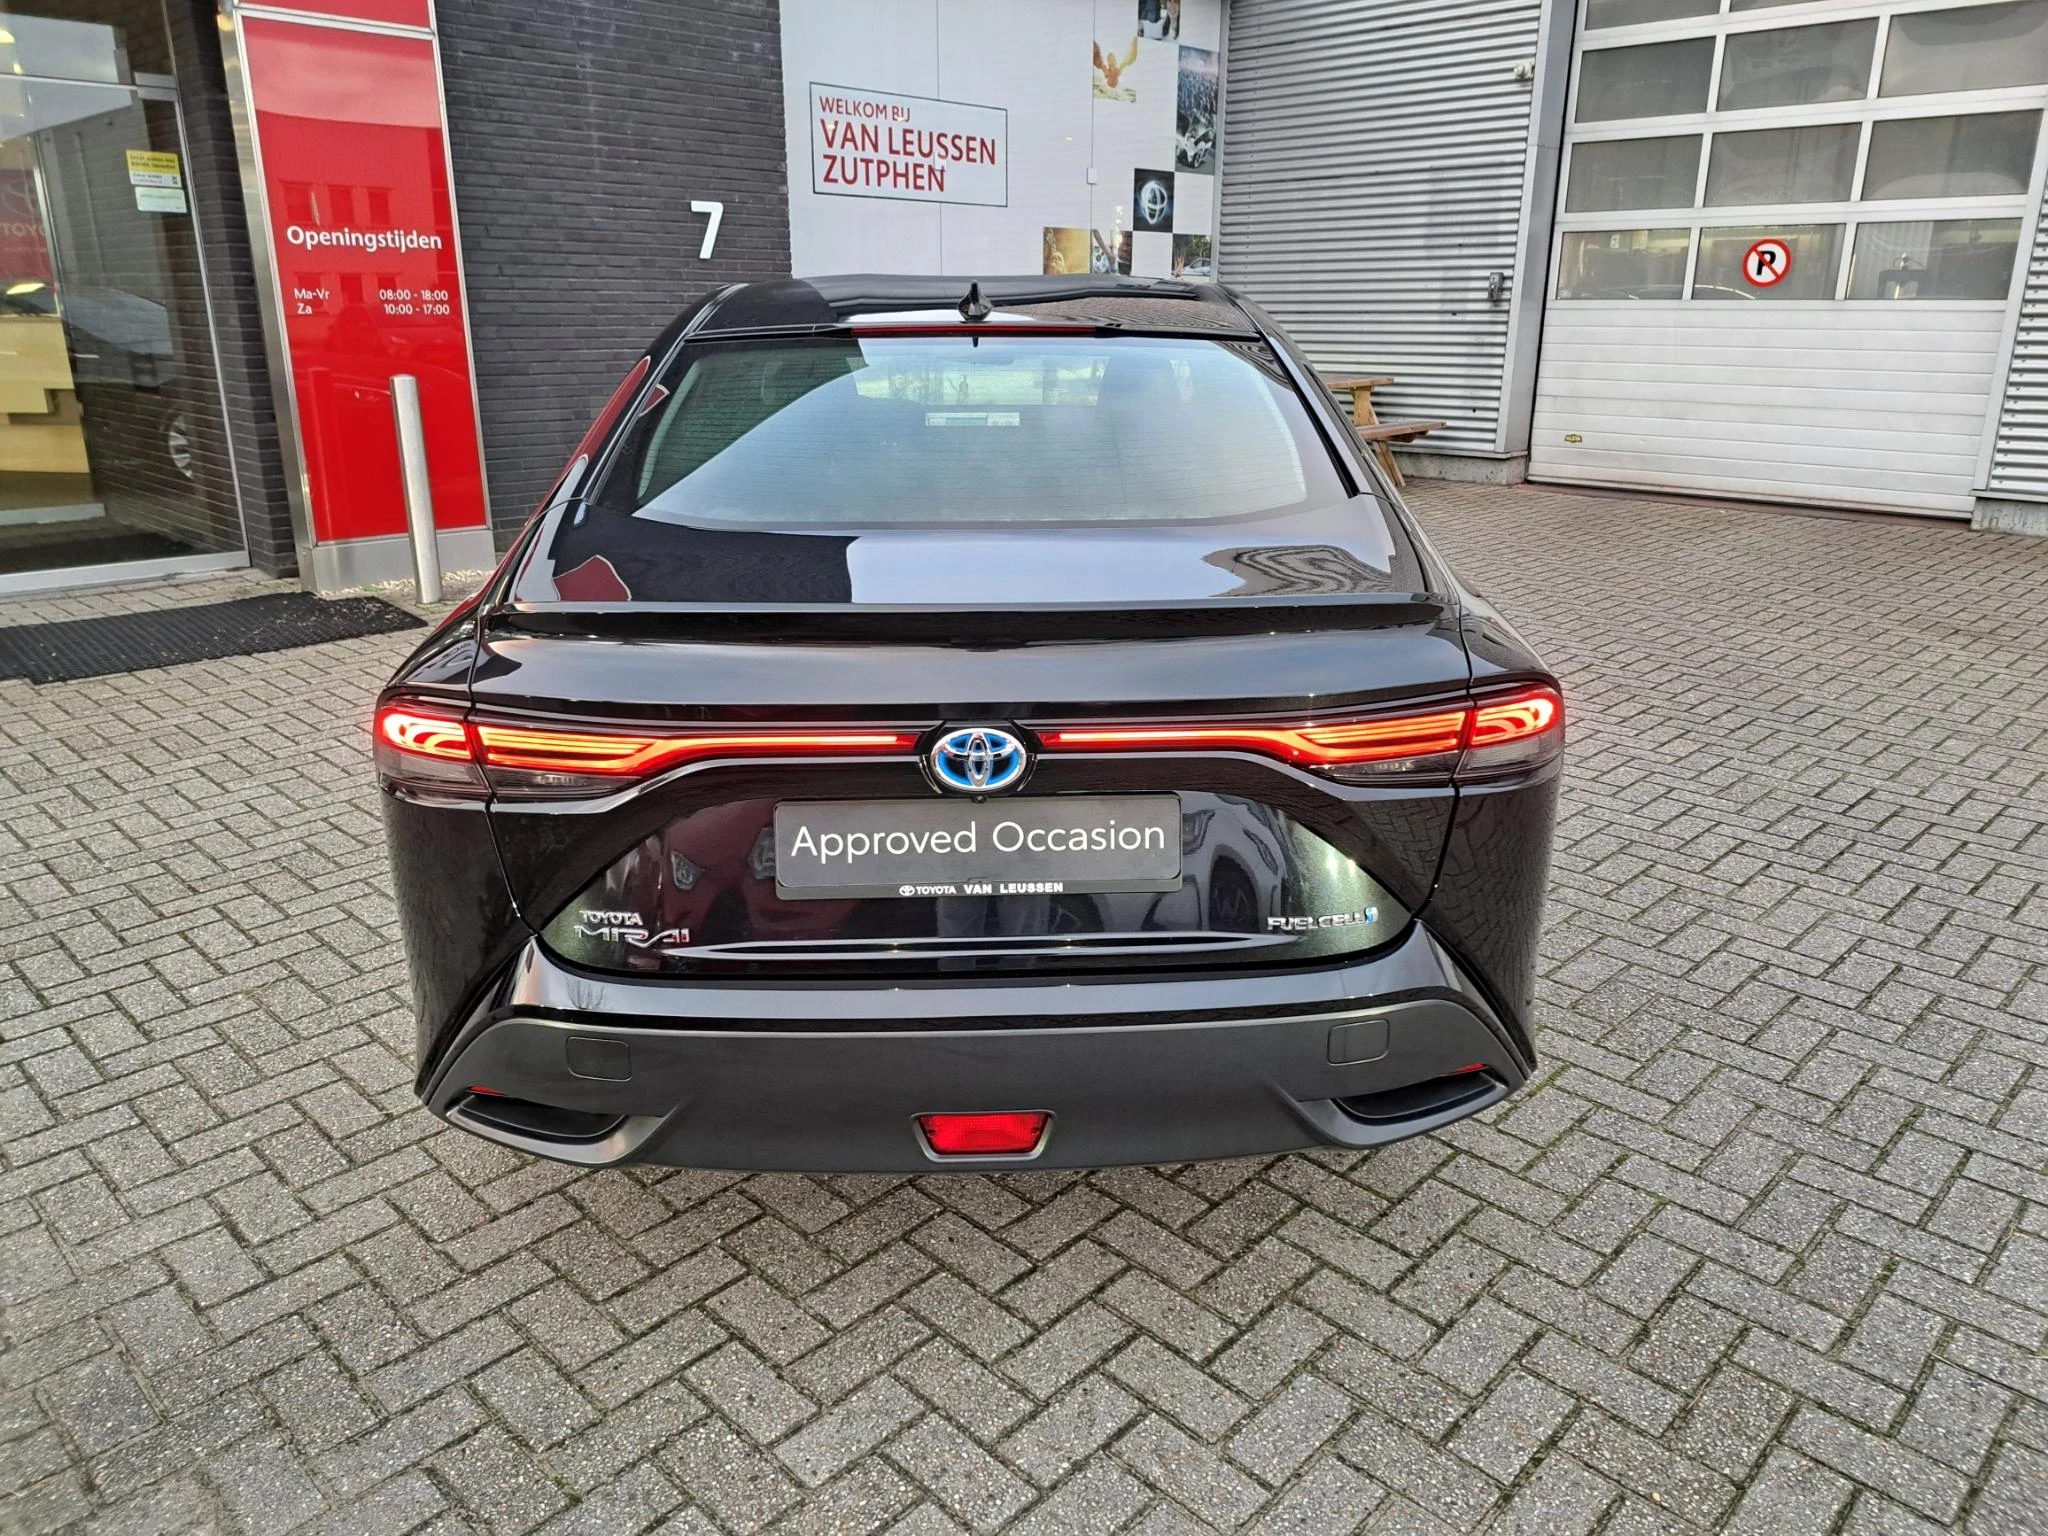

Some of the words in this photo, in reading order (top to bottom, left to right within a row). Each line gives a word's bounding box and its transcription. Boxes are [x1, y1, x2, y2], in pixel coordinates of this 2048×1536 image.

[818, 95, 888, 120] WELKOM
[891, 105, 912, 123] BIJ
[819, 118, 880, 154] VAN
[887, 126, 997, 166] LEUSSEN
[822, 153, 946, 193] ZUTPHEN
[286, 225, 443, 253] Openingstijden
[690, 200, 724, 259] 7
[293, 287, 331, 300] Ma-Vr
[378, 288, 411, 301] 08:00
[420, 289, 449, 301] 18:00
[296, 302, 313, 315] Za
[384, 303, 413, 315] 10:00
[422, 303, 450, 315] 17:00
[790, 820, 977, 865] Approved
[992, 818, 1166, 853] Occasion
[915, 885, 957, 895] TOYOTA
[963, 883, 993, 895] VAN
[999, 882, 1064, 894] LEUSSEN
[579, 910, 644, 926] TOYOTA
[574, 925, 690, 948] MIRAI
